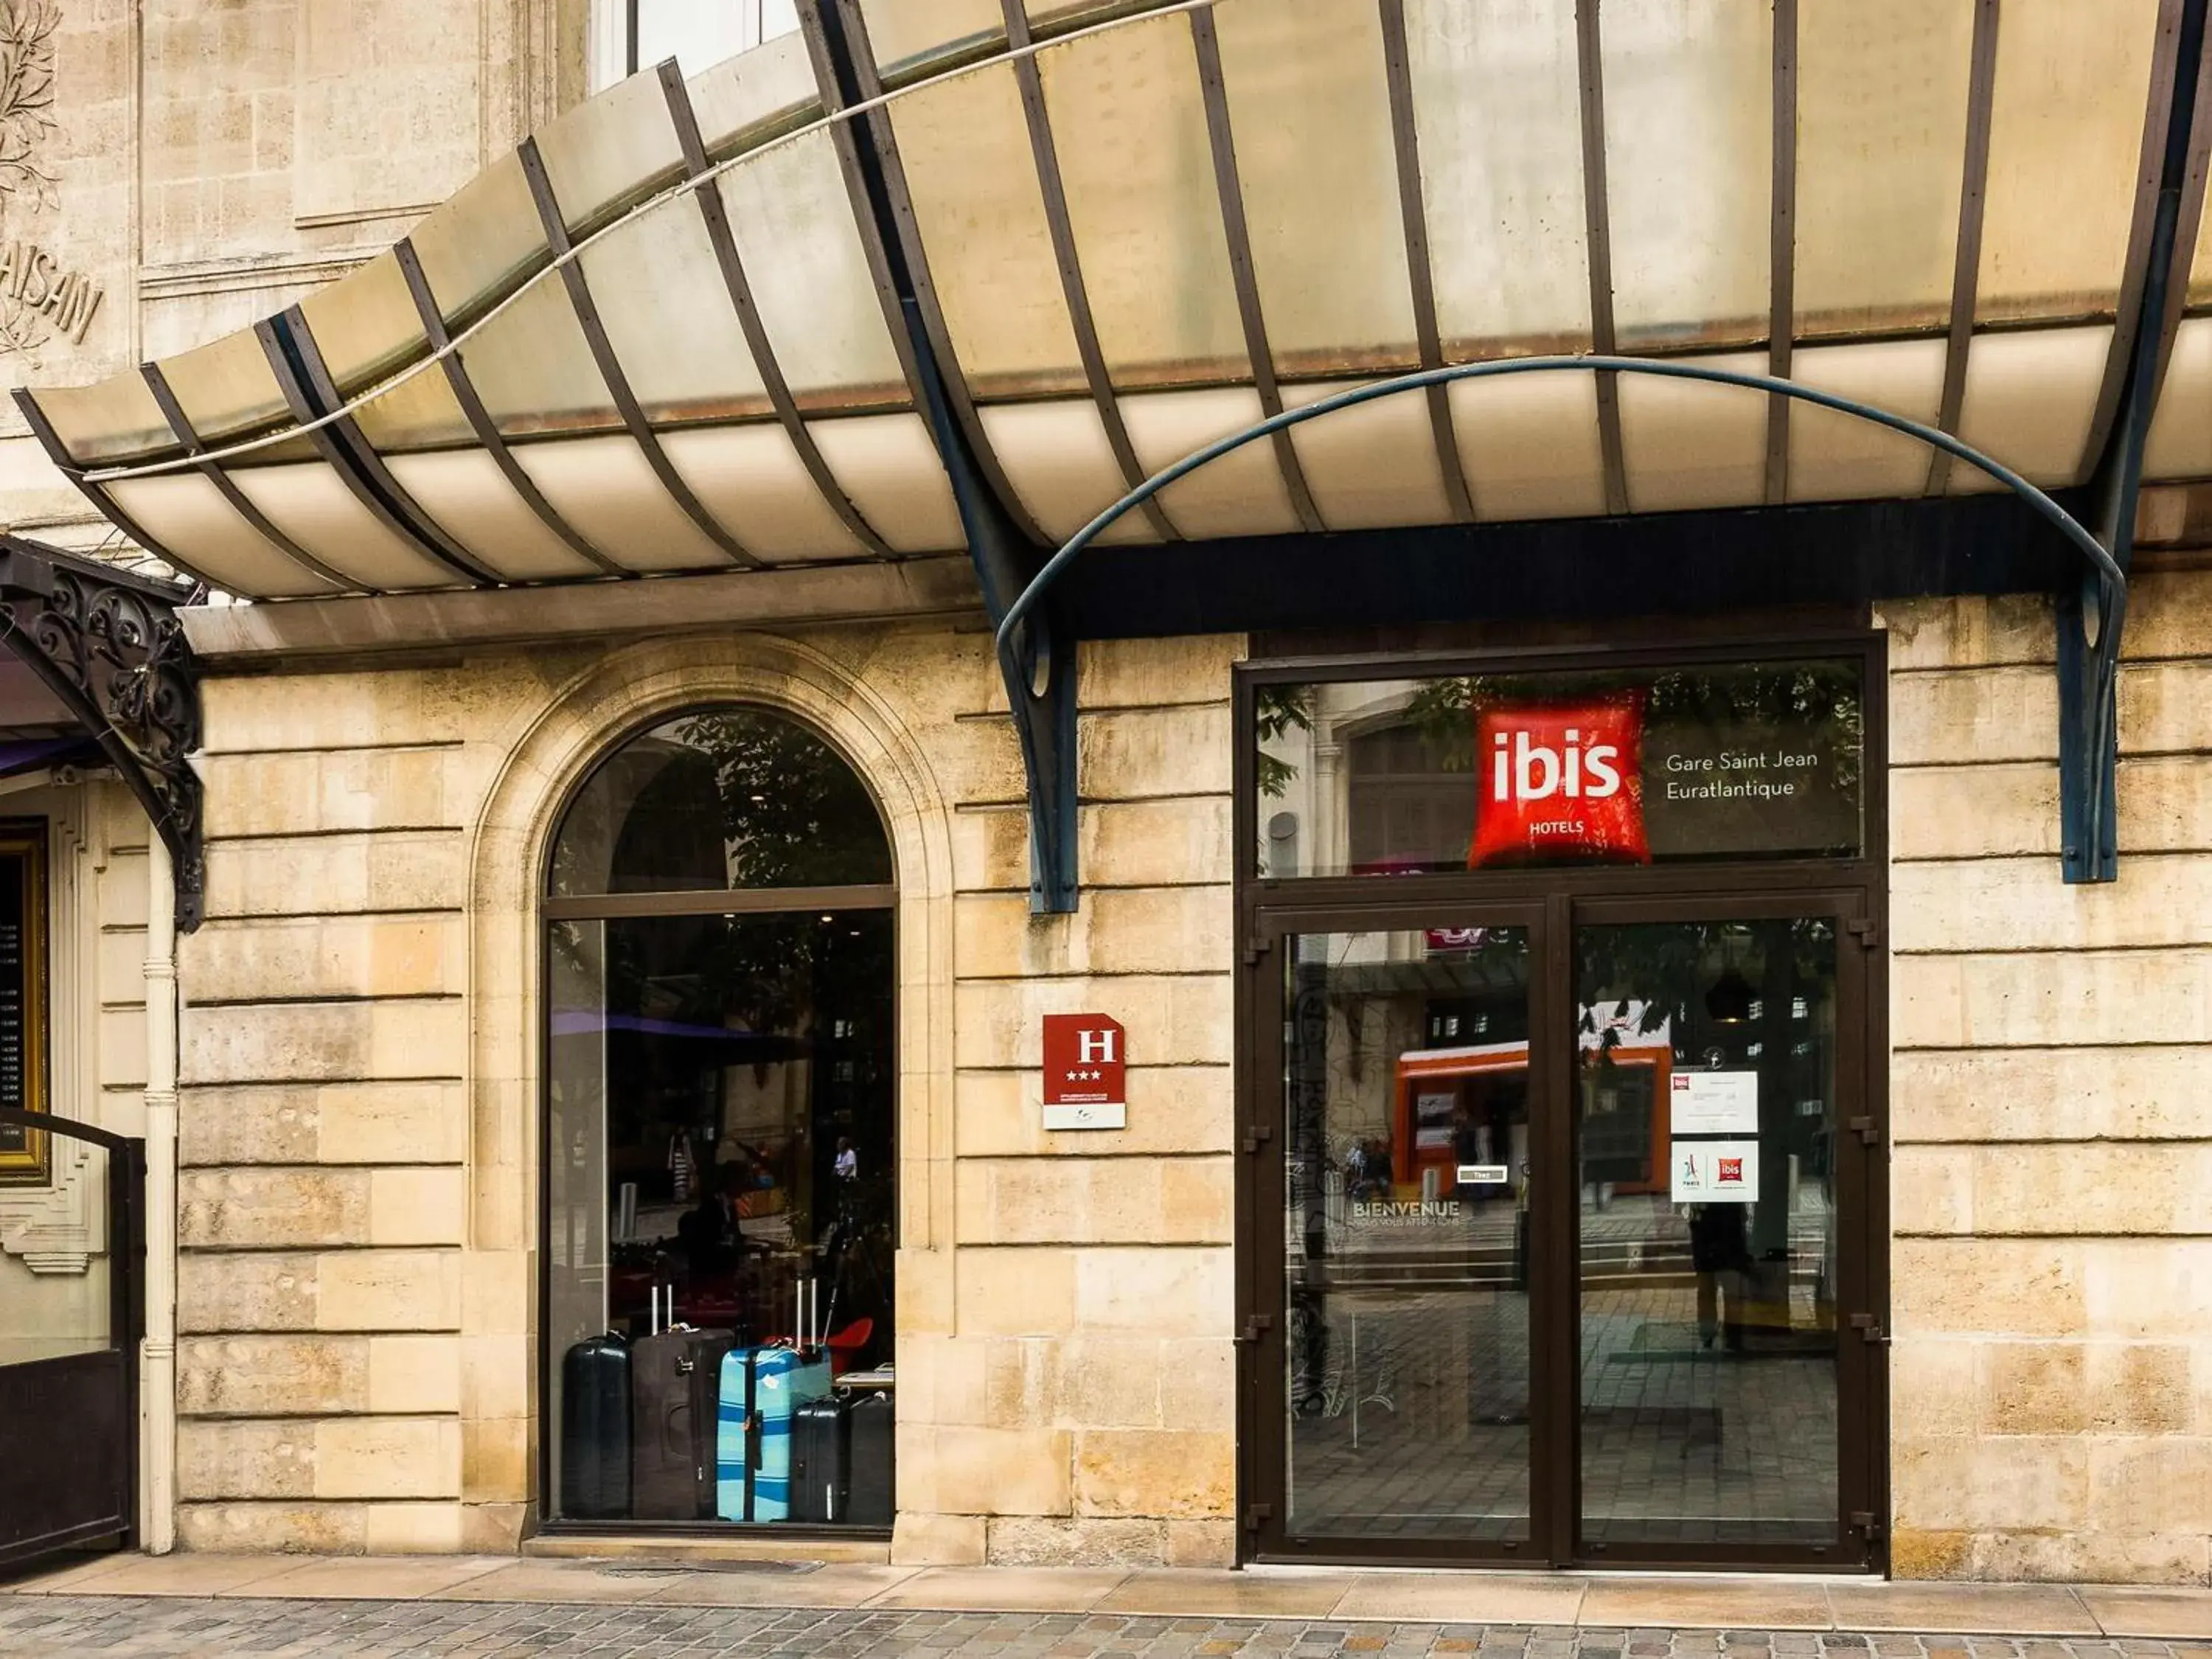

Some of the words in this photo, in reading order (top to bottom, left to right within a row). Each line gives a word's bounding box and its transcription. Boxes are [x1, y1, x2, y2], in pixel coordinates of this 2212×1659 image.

[1495, 728, 1620, 802] ibis
[1666, 754, 1713, 771] Gare
[1719, 752, 1767, 769] Saint
[1773, 751, 1818, 768] Jean
[1667, 779, 1794, 799] Euratlantique
[1529, 821, 1585, 835] HOTELS
[1077, 1029, 1117, 1064] H
[1722, 1161, 1739, 1175] ibis
[1354, 1201, 1460, 1217] BIENVENUE
